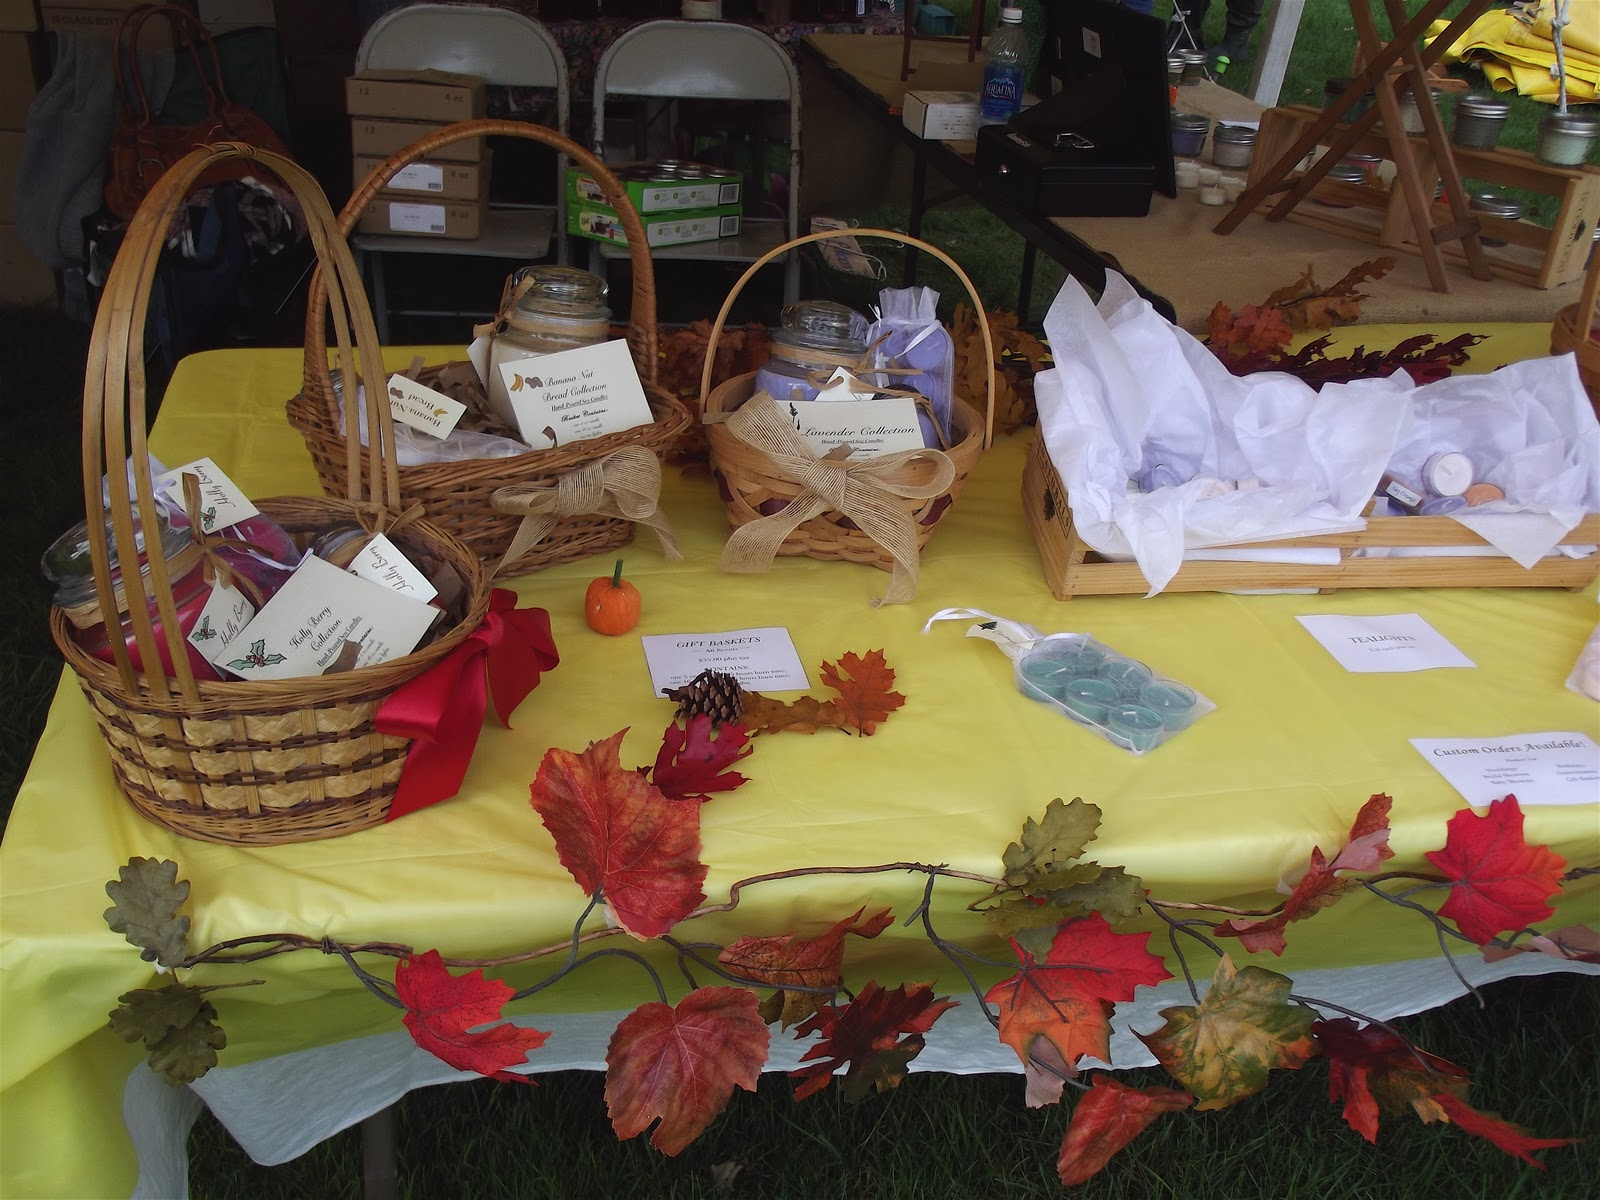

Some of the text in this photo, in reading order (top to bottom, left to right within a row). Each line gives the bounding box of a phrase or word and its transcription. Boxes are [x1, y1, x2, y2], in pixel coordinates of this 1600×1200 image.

[359, 87, 370, 96] 12
[984, 81, 1016, 99] AQUAFINA
[365, 126, 376, 135] 12
[544, 369, 594, 388] Banana Nut
[542, 383, 607, 403] Bread Collection
[408, 394, 435, 411] Bread
[390, 400, 441, 427] Banana Nut
[800, 425, 916, 438] Lavender Collection
[193, 465, 236, 507] Holly Berry
[369, 545, 414, 590] Holly Berry
[220, 618, 240, 649] Holly
[289, 606, 332, 650] Holly Berry
[310, 618, 342, 653] Collection
[676, 636, 762, 649] GIFT BASKETS
[1347, 635, 1417, 644] TEALIGHTS
[1433, 740, 1587, 757] Custom Orders Available!
